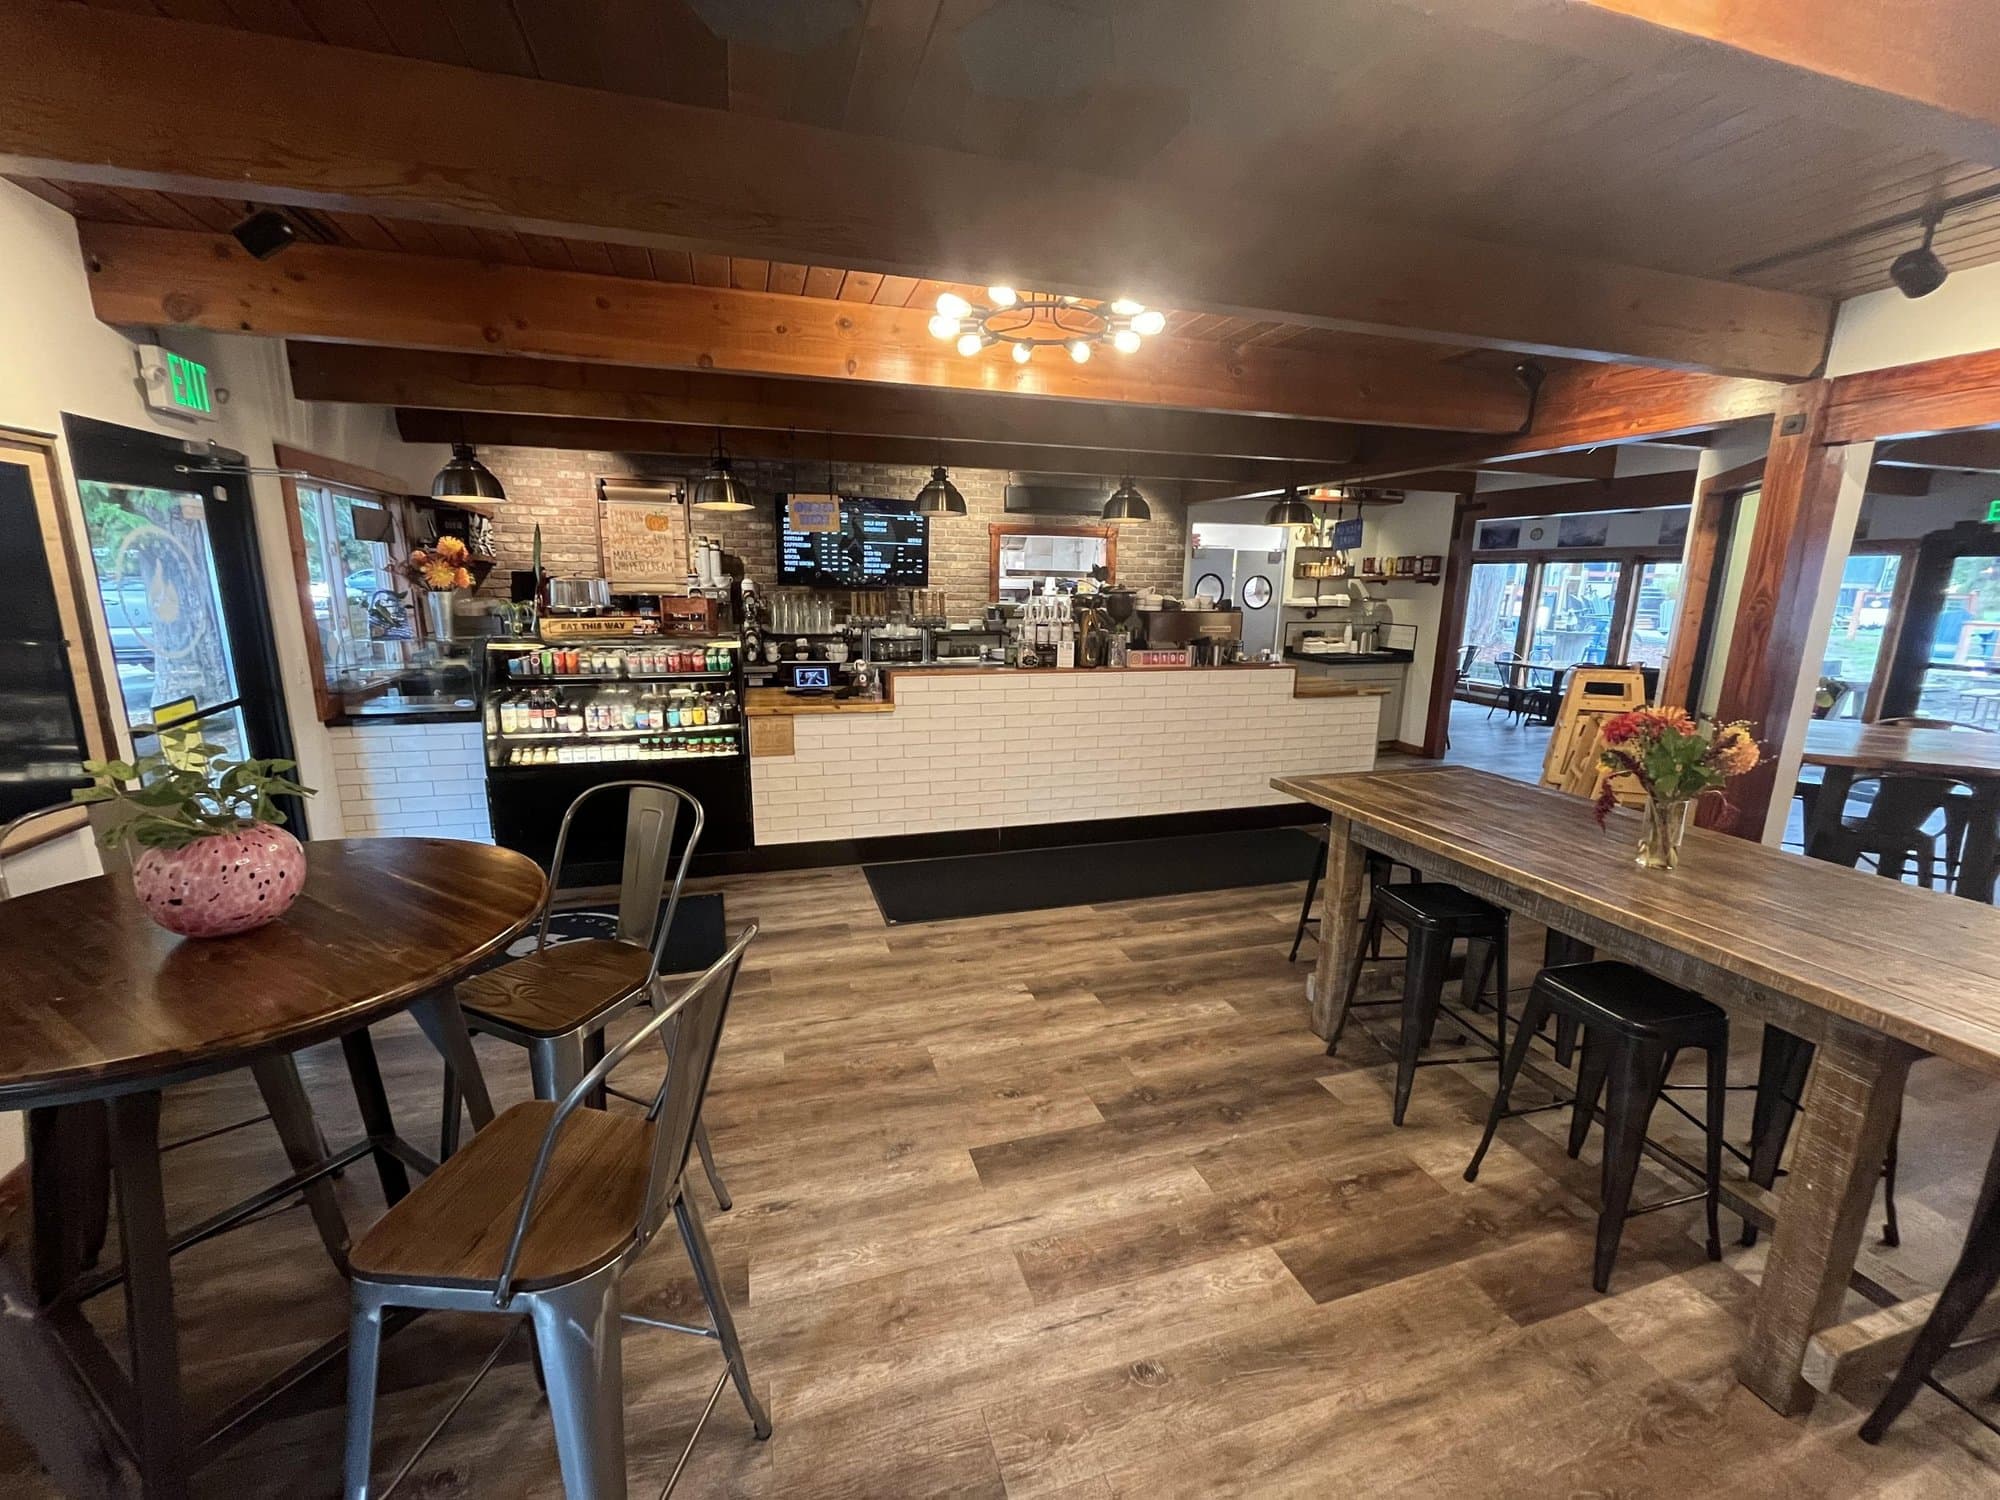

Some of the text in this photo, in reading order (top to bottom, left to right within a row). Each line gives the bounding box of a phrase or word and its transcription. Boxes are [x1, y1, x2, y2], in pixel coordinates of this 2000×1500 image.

[167, 352, 210, 413] EXIT
[561, 622, 625, 631] EAT THIS WAY
